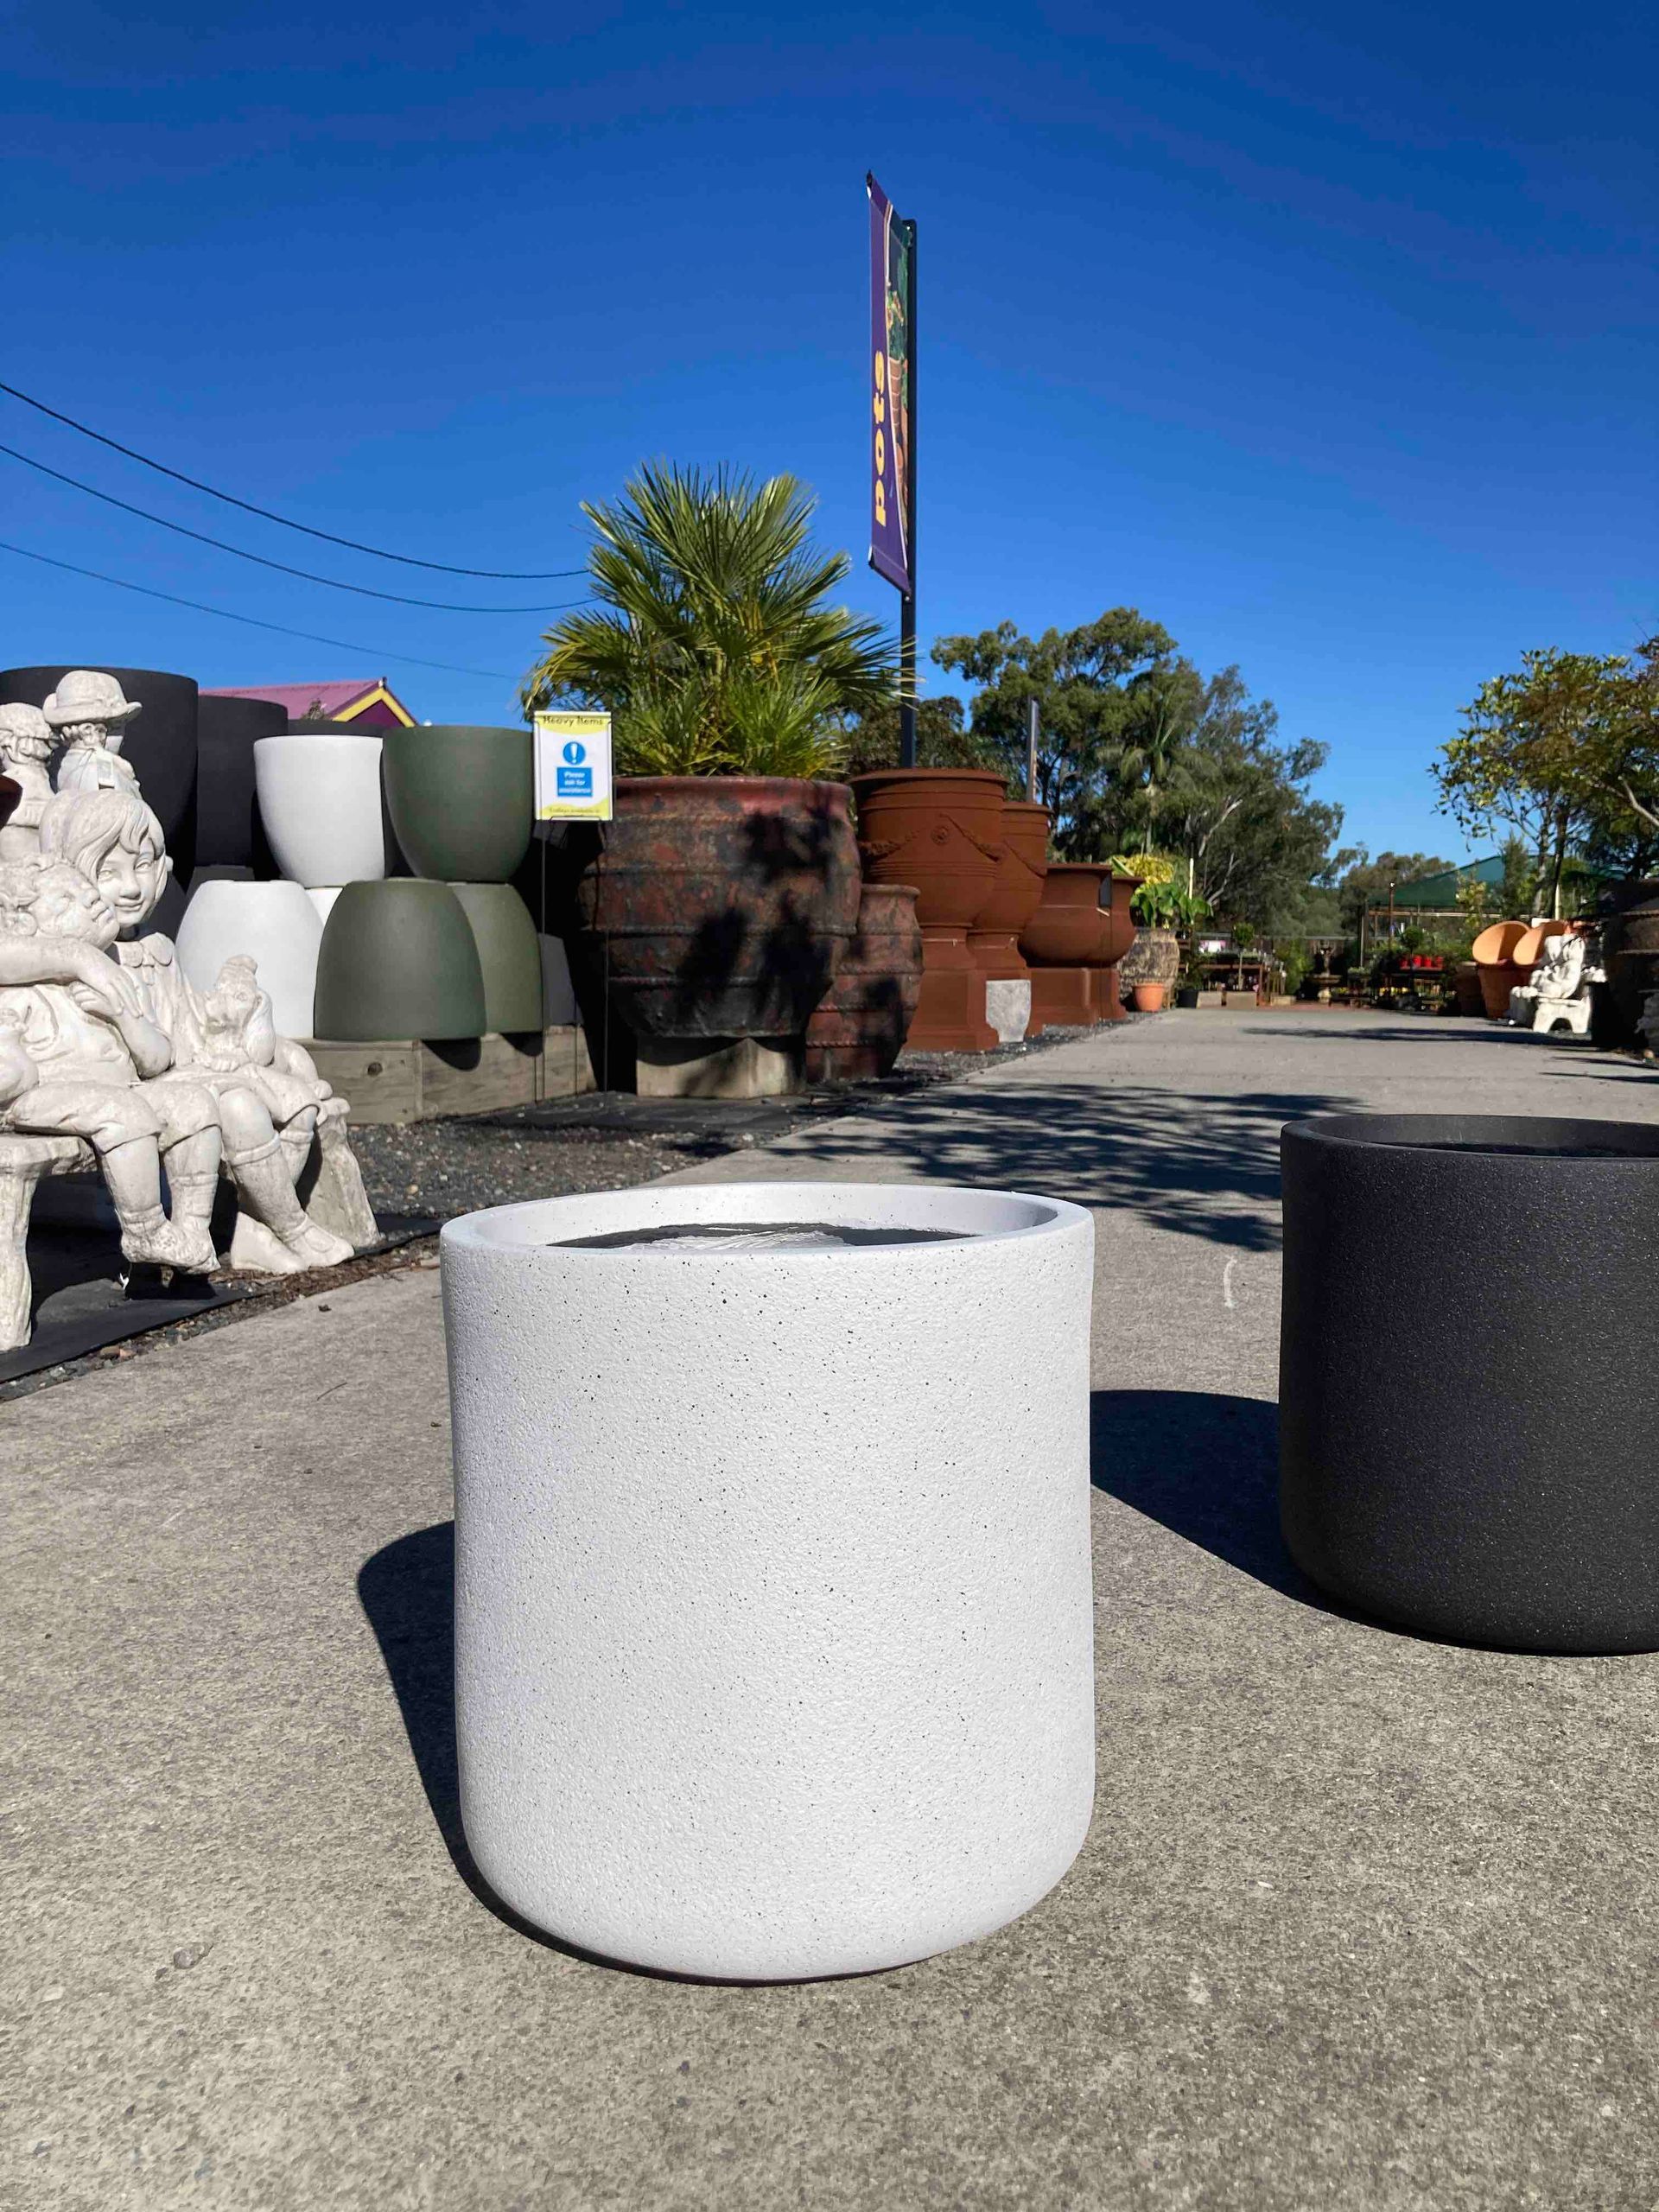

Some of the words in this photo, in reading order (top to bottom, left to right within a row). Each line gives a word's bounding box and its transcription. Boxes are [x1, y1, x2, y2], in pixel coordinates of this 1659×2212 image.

[874, 350, 887, 527] pots
[543, 715, 575, 728] Heavy
[577, 715, 603, 726] Items
